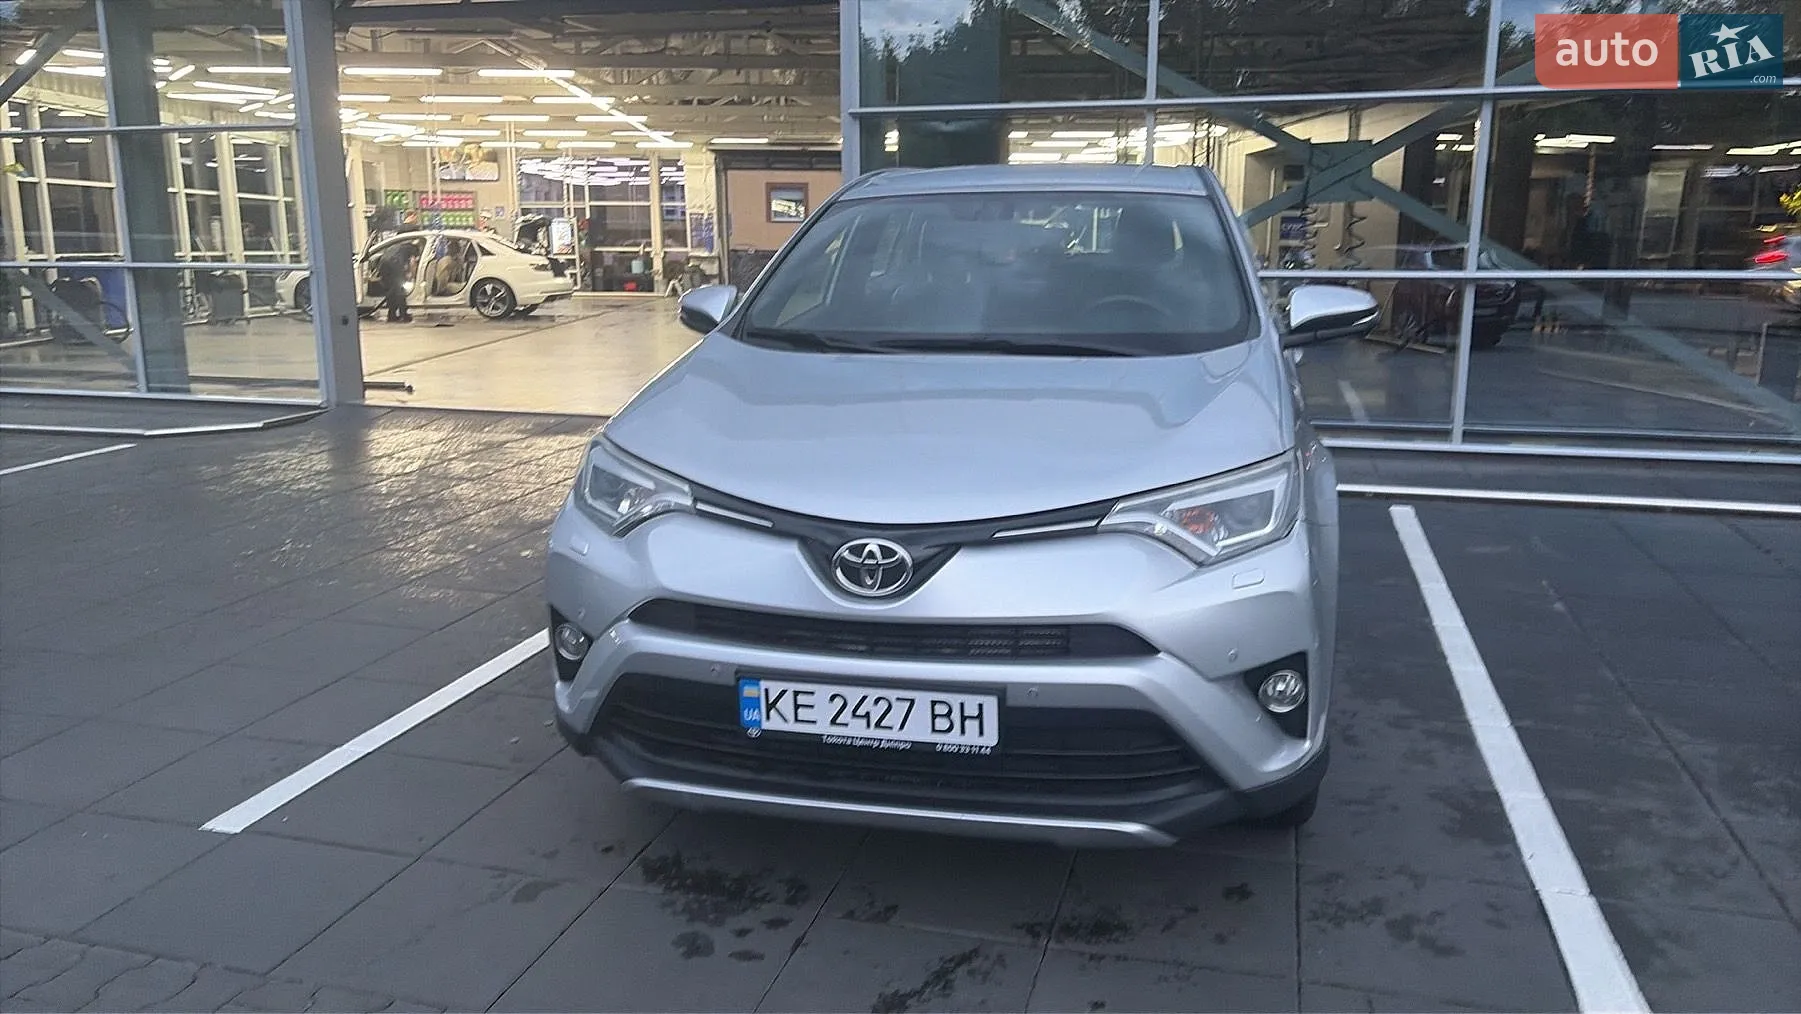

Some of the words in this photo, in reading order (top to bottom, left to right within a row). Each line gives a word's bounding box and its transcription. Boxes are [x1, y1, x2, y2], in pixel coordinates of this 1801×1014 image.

[743, 708, 760, 721] UA
[764, 687, 818, 725] KE
[827, 693, 917, 732] 2427
[930, 699, 985, 738] BH
